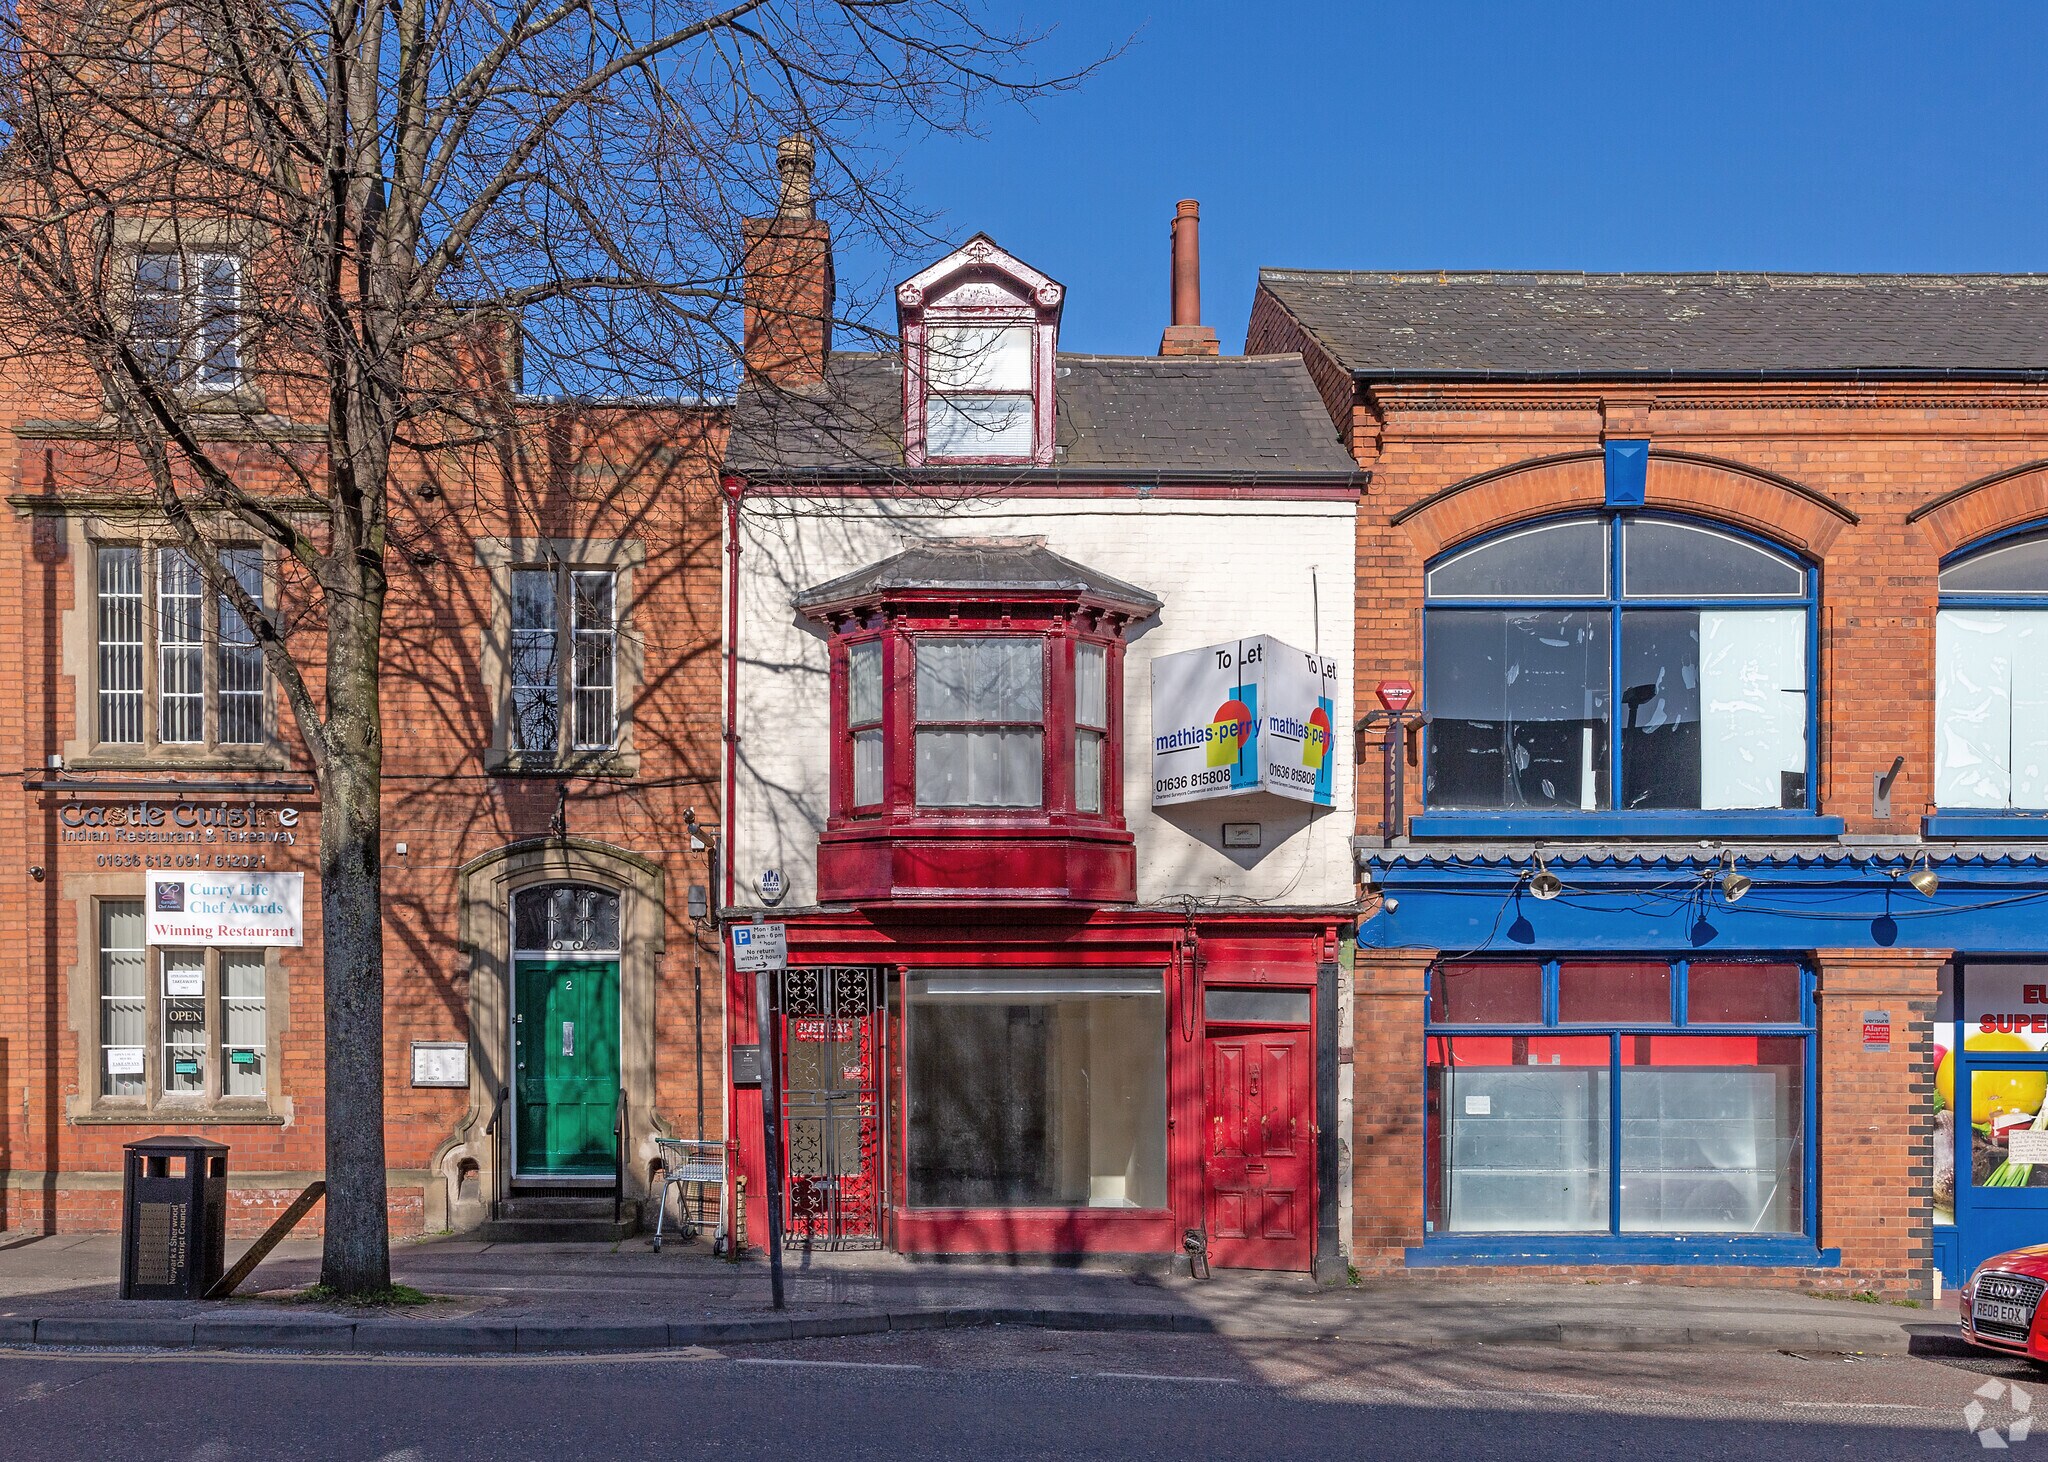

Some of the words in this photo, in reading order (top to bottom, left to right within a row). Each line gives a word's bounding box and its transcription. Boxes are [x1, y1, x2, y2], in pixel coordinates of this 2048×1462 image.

[1216, 650, 1232, 670] To
[1238, 640, 1262, 665] Let
[1304, 654, 1318, 674] To
[1319, 656, 1336, 680] Let
[1156, 776, 1188, 792] 01636
[1191, 769, 1231, 786] 815808
[1270, 762, 1290, 780] 01636
[1291, 768, 1316, 786] 815808
[60, 801, 166, 828] Castle
[172, 801, 300, 828] Cuisine
[62, 828, 110, 842] Indian
[116, 828, 202, 842] Restaurant
[206, 828, 217, 842] &
[222, 828, 298, 846] Takeaway
[96, 854, 141, 868] 01636
[144, 854, 172, 868] 612
[175, 854, 201, 868] 091
[215, 854, 266, 869] 612021
[762, 870, 780, 882] APA
[190, 883, 235, 898] Curry
[240, 883, 269, 896] Life
[190, 901, 226, 914] Chef
[228, 902, 284, 914] Awards
[154, 924, 214, 938] Winning
[218, 924, 295, 938] Restaurant
[738, 932, 748, 944] P
[566, 980, 572, 990] 2
[169, 1010, 202, 1022] OPEN
[1980, 1014, 2048, 1034] SUPE
[798, 1022, 824, 1033] JUST
[169, 1205, 179, 1247] Sherwood
[178, 1203, 187, 1235] Council
[177, 1237, 186, 1268] District
[1977, 1302, 1998, 1318] RE08
[2001, 1306, 2022, 1322] EOX
